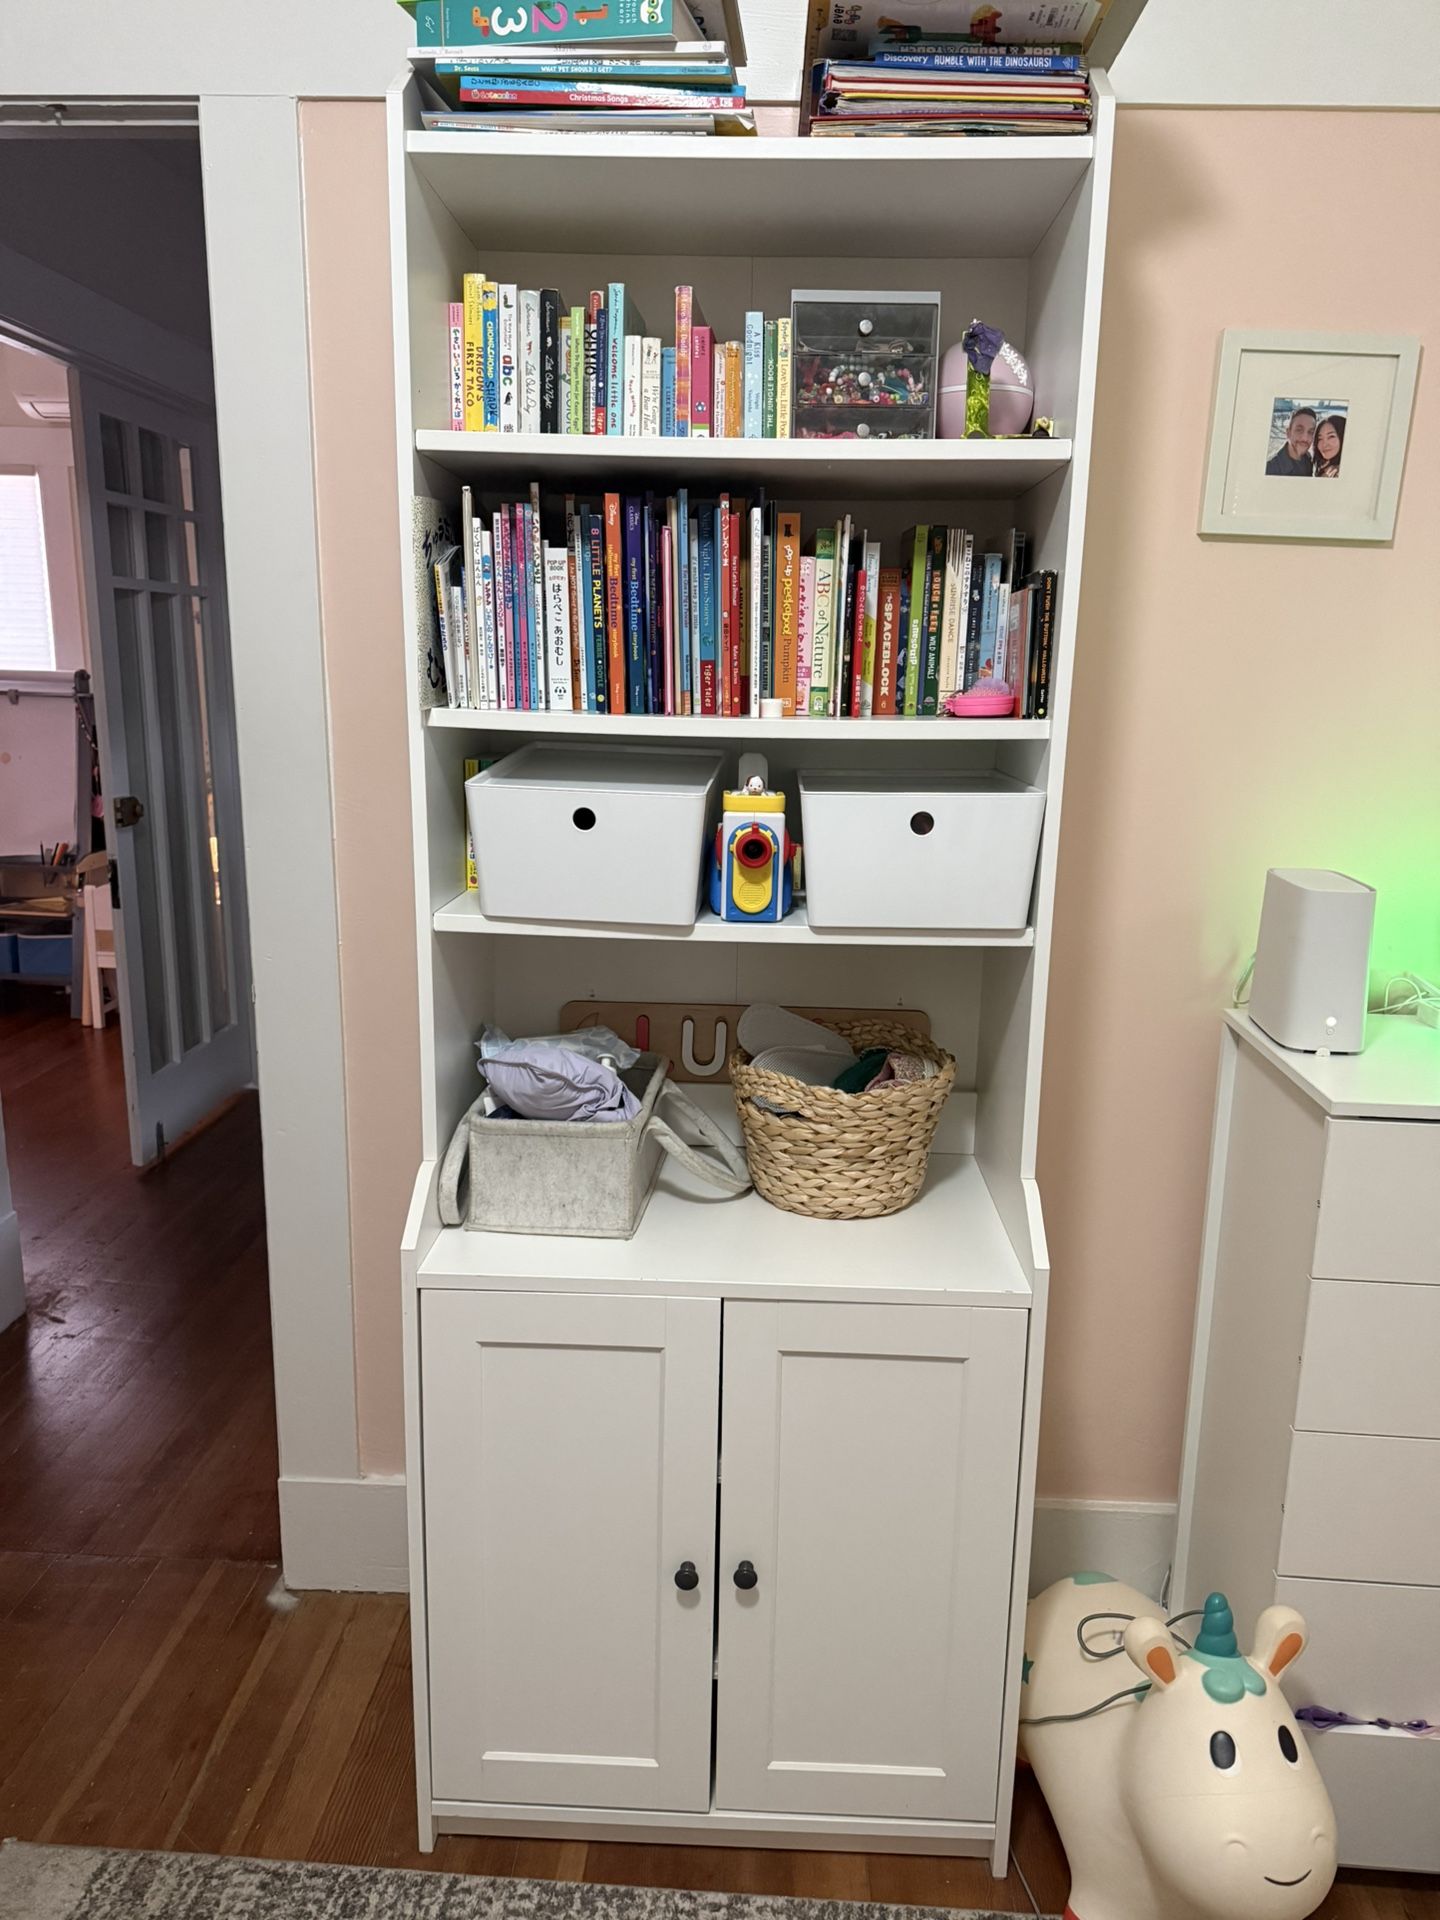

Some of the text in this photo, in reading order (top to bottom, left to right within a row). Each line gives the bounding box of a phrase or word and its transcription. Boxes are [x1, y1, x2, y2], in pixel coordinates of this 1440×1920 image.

[491, 6, 528, 36] 3
[533, 2, 568, 33] 2
[884, 54, 928, 63] Discovery
[934, 56, 1052, 67] RUMBLE WITH THE DINOSAURS!
[570, 94, 629, 104] Christmas Songs
[680, 299, 688, 317] Love
[680, 334, 688, 357] Daddy
[746, 324, 754, 365] Goodnight
[466, 341, 474, 407] FIRST TACO
[502, 355, 514, 386] abc
[610, 338, 620, 428] welcome little one
[780, 364, 790, 382] Love
[780, 383, 790, 398] You,
[596, 413, 604, 430] tiger
[650, 406, 658, 425] Going
[780, 400, 790, 418] Little
[608, 503, 617, 526] Disney
[702, 512, 711, 537] Night
[592, 540, 602, 575] LITTLE
[762, 544, 770, 564] WHERE
[784, 545, 794, 576] pop-up
[762, 566, 770, 576] THE
[762, 577, 770, 592] WILD
[932, 570, 940, 601] TOUCH
[592, 580, 602, 628] PLANETS
[609, 577, 620, 628] Bedtime
[630, 558, 640, 660] my first Bedtime storybook
[702, 573, 712, 626] Dino-Snores
[782, 578, 795, 636] peekaboo!
[947, 584, 957, 642] SUNRISE DANCE
[552, 583, 564, 666] はらぺこ あおむし
[762, 612, 770, 623] ARE
[814, 568, 832, 678] ABC of Nature
[880, 603, 893, 696] SPACEBLOCK
[909, 619, 918, 665] dinosaurs
[928, 636, 937, 650] WILD
[596, 634, 604, 687] FERRIE DOYLE
[762, 644, 770, 690] KATIE BLACKBURN
[782, 638, 793, 683] Pumpkin
[927, 652, 936, 679] ANIMALS
[1040, 650, 1048, 684] HALLOWEEN
[703, 665, 712, 706] tiger tales
